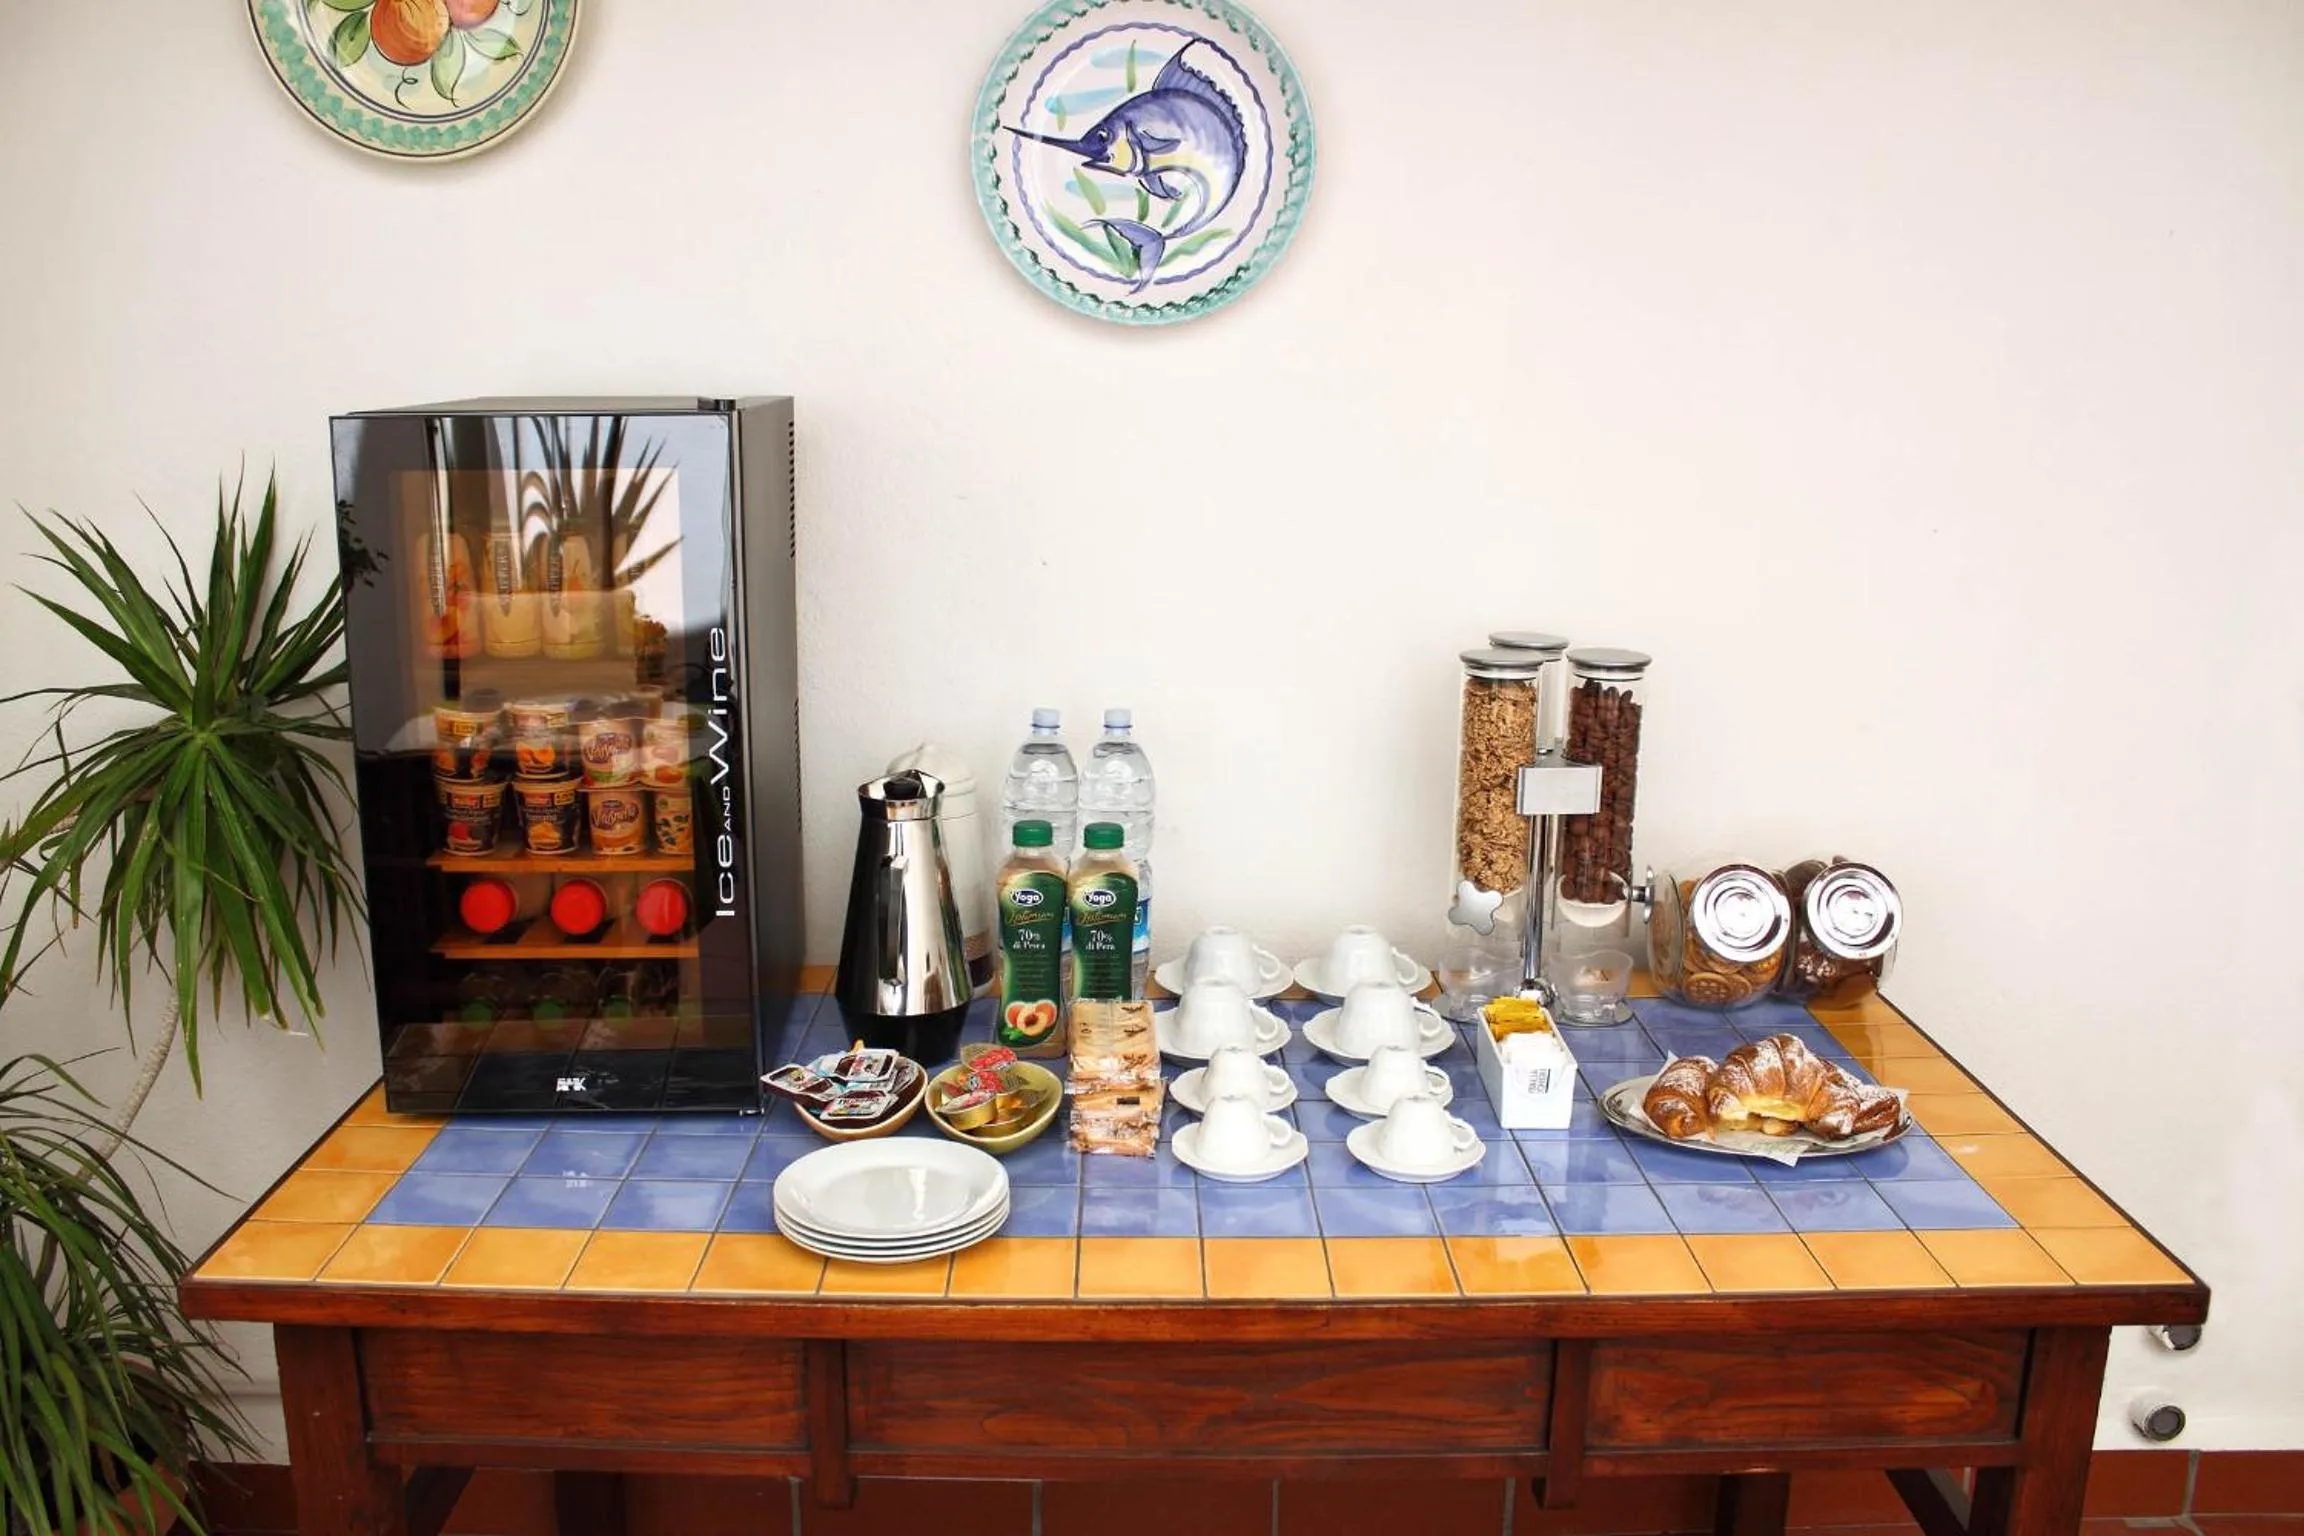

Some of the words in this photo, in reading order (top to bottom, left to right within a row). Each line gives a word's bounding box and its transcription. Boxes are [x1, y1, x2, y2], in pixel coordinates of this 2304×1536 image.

[707, 627, 730, 785] Wine
[722, 786, 732, 831] AND
[715, 834, 736, 917] Ice
[1014, 891, 1040, 905] Yoga
[1087, 892, 1112, 906] Yoga
[1018, 928, 1041, 942] 70%
[1090, 929, 1113, 943] 70%
